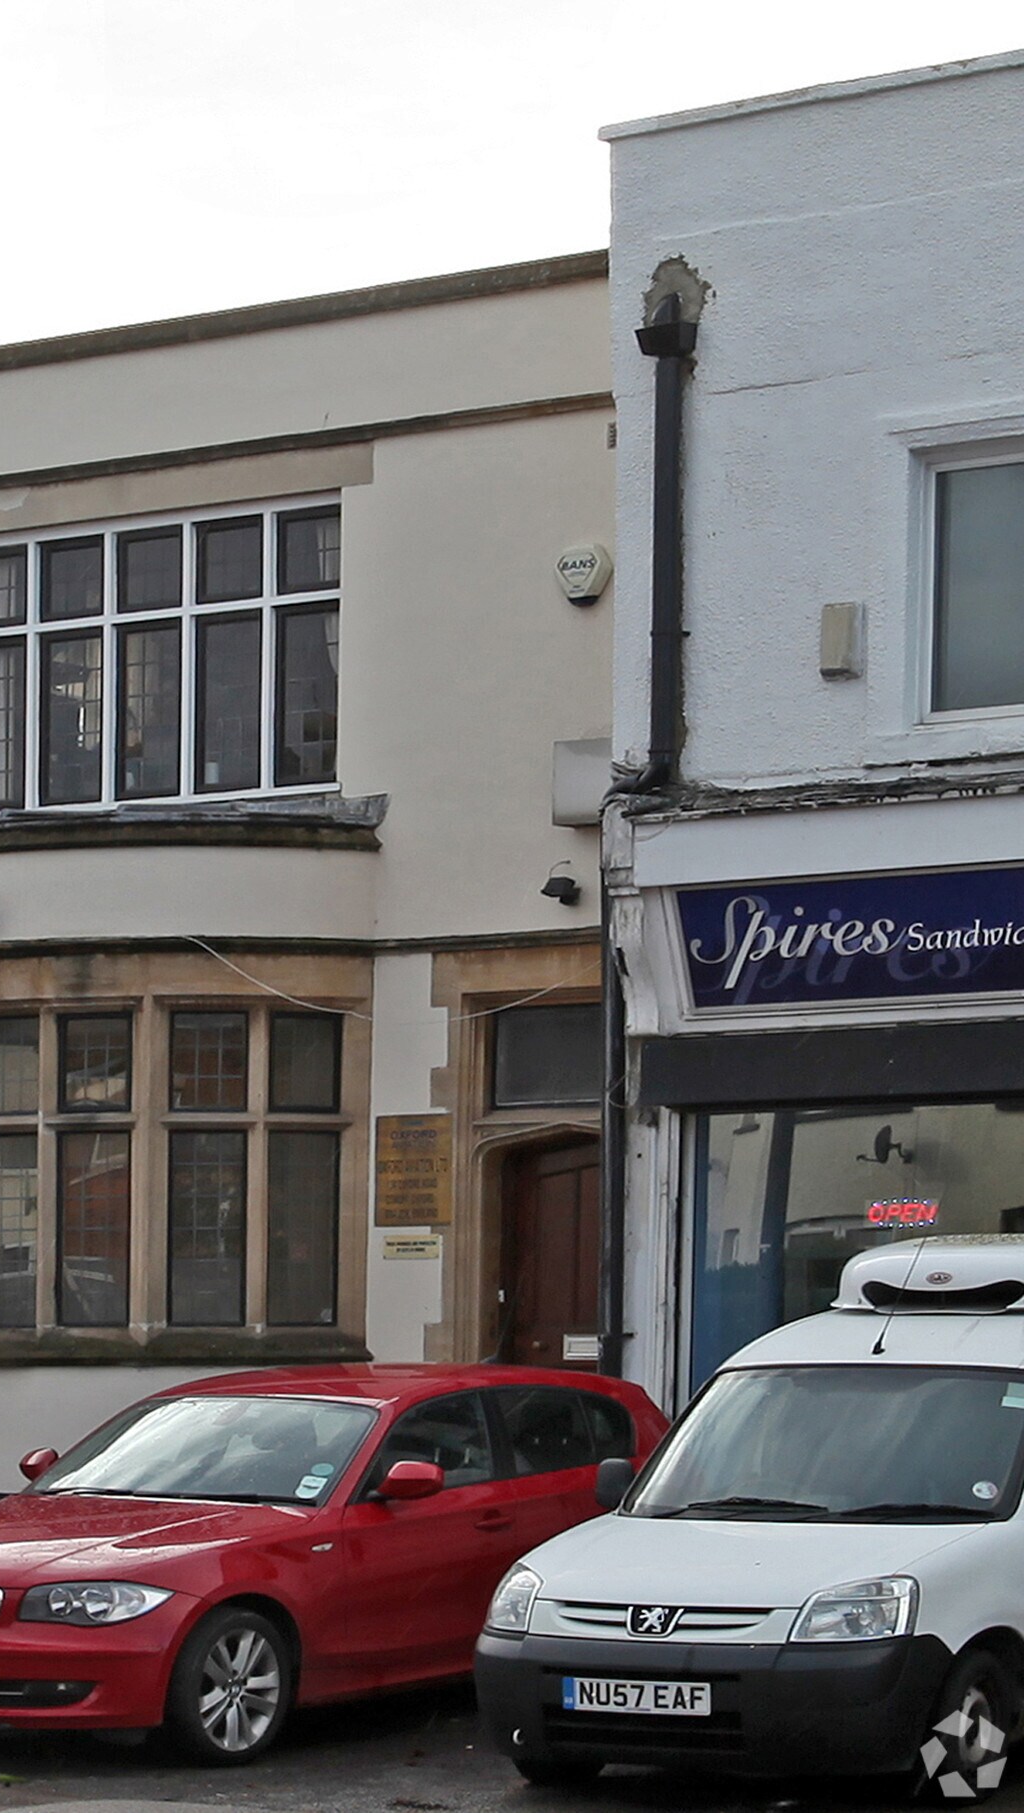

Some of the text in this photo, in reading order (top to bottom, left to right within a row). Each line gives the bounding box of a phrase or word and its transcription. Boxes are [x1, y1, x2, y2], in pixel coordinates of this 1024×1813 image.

[689, 895, 900, 989] Spires
[390, 1129, 437, 1140] OXFORD
[868, 1203, 939, 1223] OPEN
[579, 1681, 706, 1710] NU57 EAF
